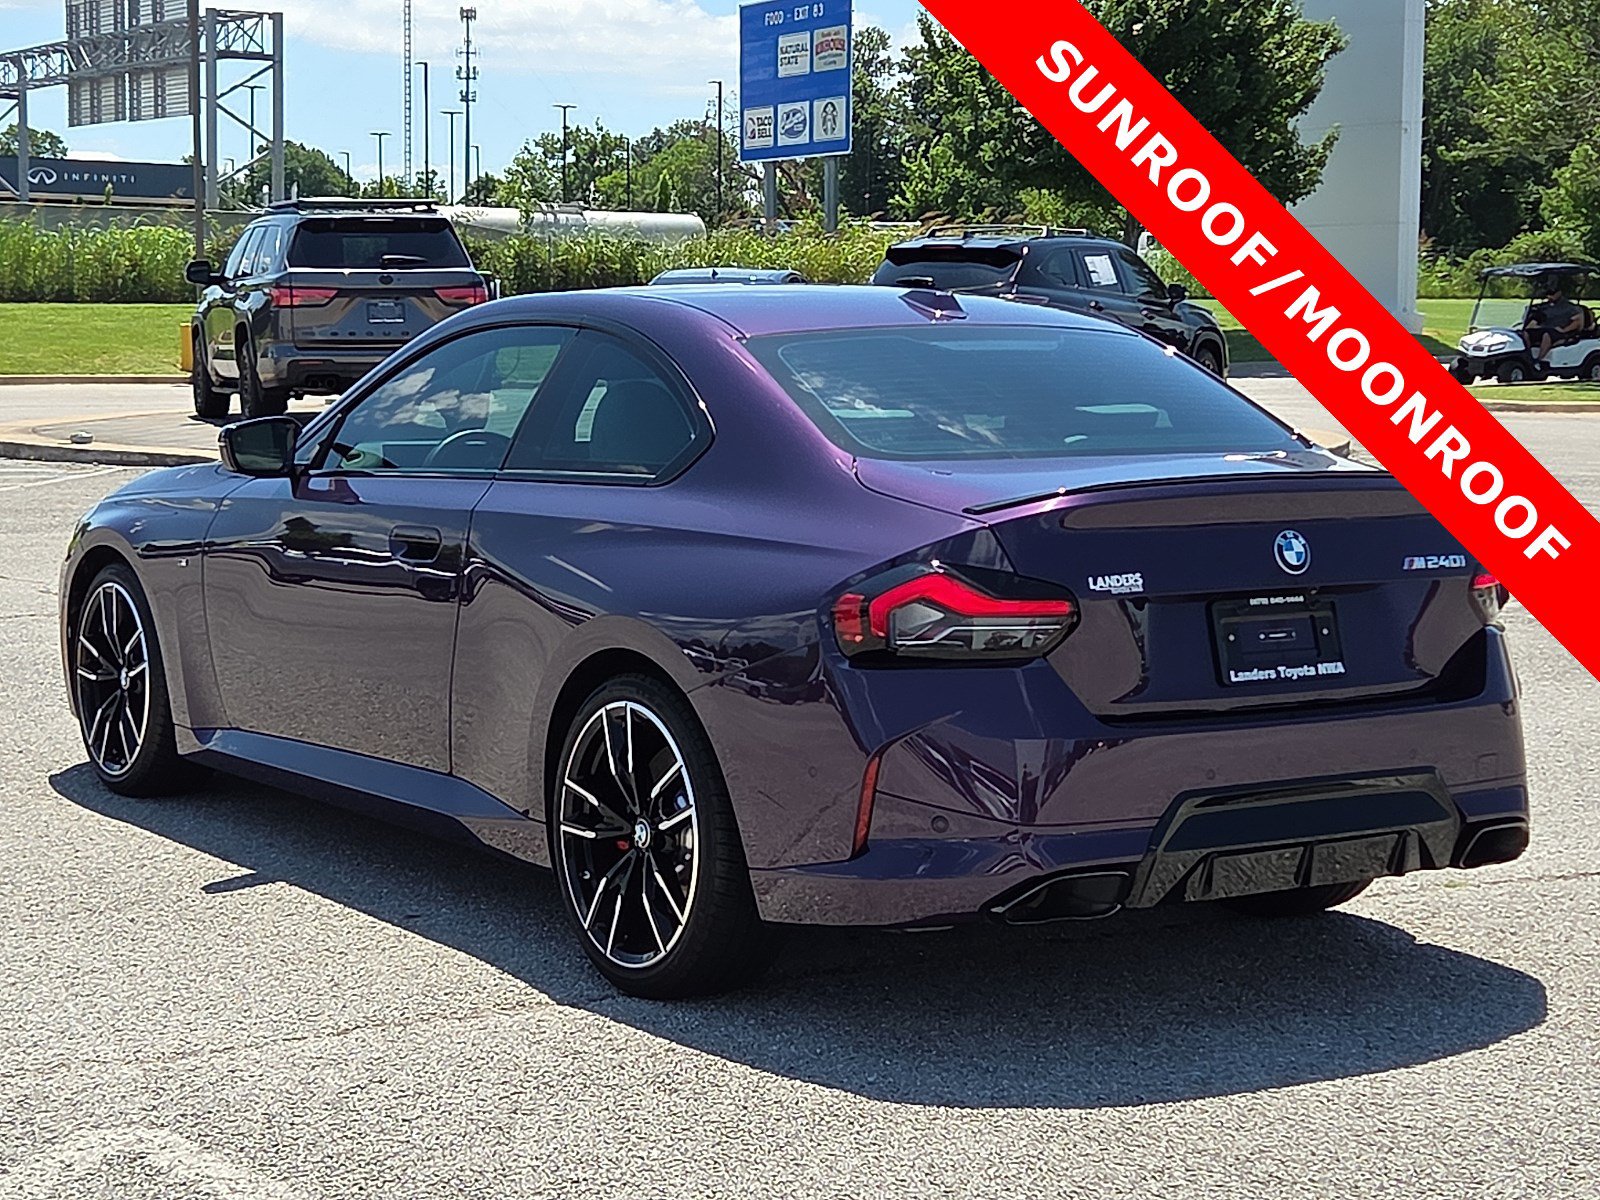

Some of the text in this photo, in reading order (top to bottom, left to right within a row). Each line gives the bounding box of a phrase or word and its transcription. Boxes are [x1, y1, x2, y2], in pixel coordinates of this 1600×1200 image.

[765, 11, 784, 26] FOOD
[794, 6, 809, 21] EXIT
[813, 3, 823, 17] 83
[780, 42, 808, 54] NATURAL
[780, 56, 798, 67] STATE
[756, 116, 773, 127] TACO
[757, 128, 772, 138] BELL
[63, 172, 136, 183] INFINITI
[1088, 573, 1143, 590] LANDERS
[1229, 668, 1277, 682] Landers
[1277, 664, 1316, 680] Toyota
